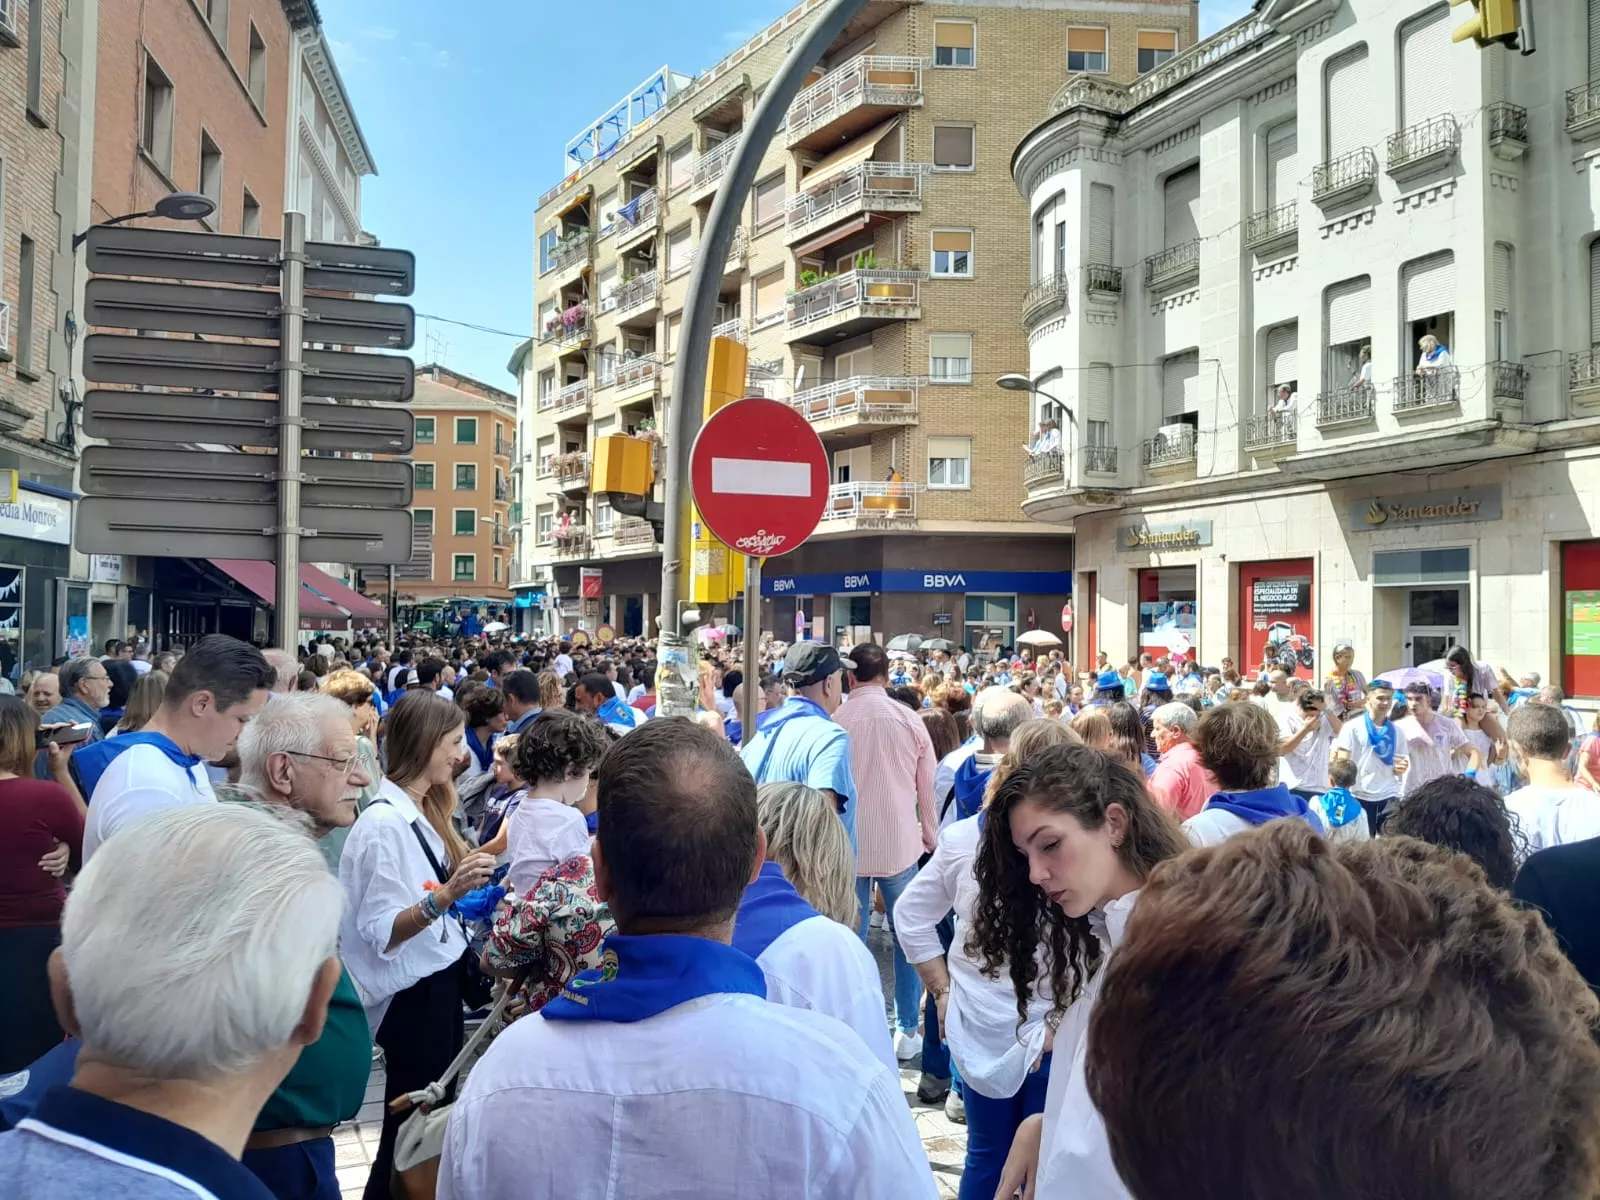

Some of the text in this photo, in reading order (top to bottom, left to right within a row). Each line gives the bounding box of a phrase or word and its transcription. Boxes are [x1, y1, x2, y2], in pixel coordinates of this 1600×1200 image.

[22, 503, 57, 527] Monros
[1388, 497, 1480, 521] Santander
[1139, 526, 1197, 545] Santander
[773, 579, 795, 592] BBVA
[844, 574, 870, 588] BBVA
[924, 574, 966, 588] BBVA
